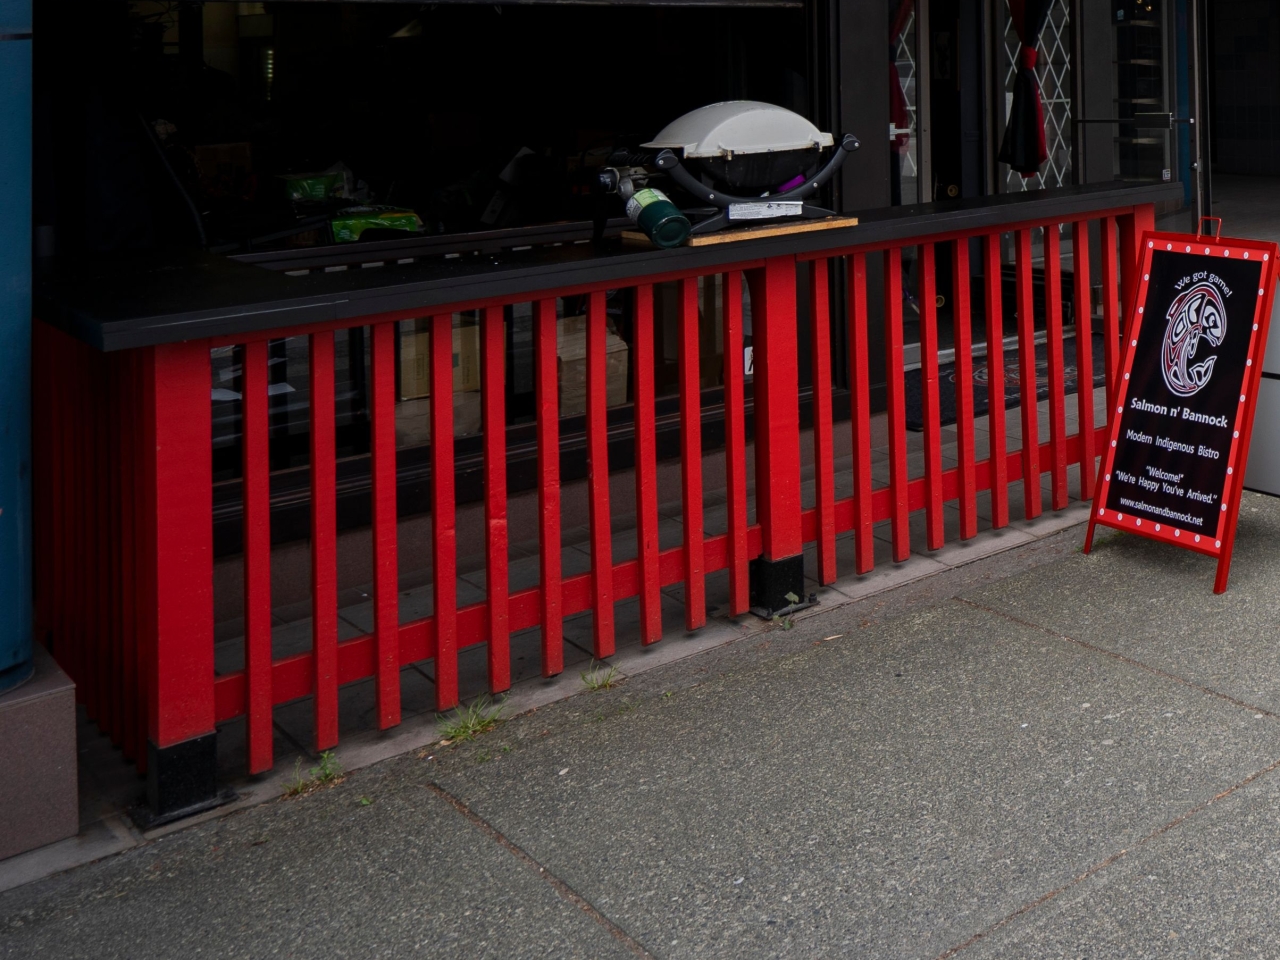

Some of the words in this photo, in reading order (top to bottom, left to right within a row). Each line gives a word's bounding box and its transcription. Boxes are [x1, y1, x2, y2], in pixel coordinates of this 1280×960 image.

[1174, 276, 1190, 290] We
[1193, 271, 1207, 282] got
[1208, 273, 1233, 298] game!
[1131, 397, 1167, 416] Salmon
[1170, 407, 1180, 417] n'
[1182, 408, 1228, 428] Bannock
[1126, 429, 1153, 444] Modern
[1155, 436, 1194, 454] Indigenous
[1198, 445, 1220, 459] Bistro
[1138, 477, 1159, 492] Happy
[1162, 483, 1184, 497] You've
[1120, 497, 1203, 526] www.salmonandbannock.net
